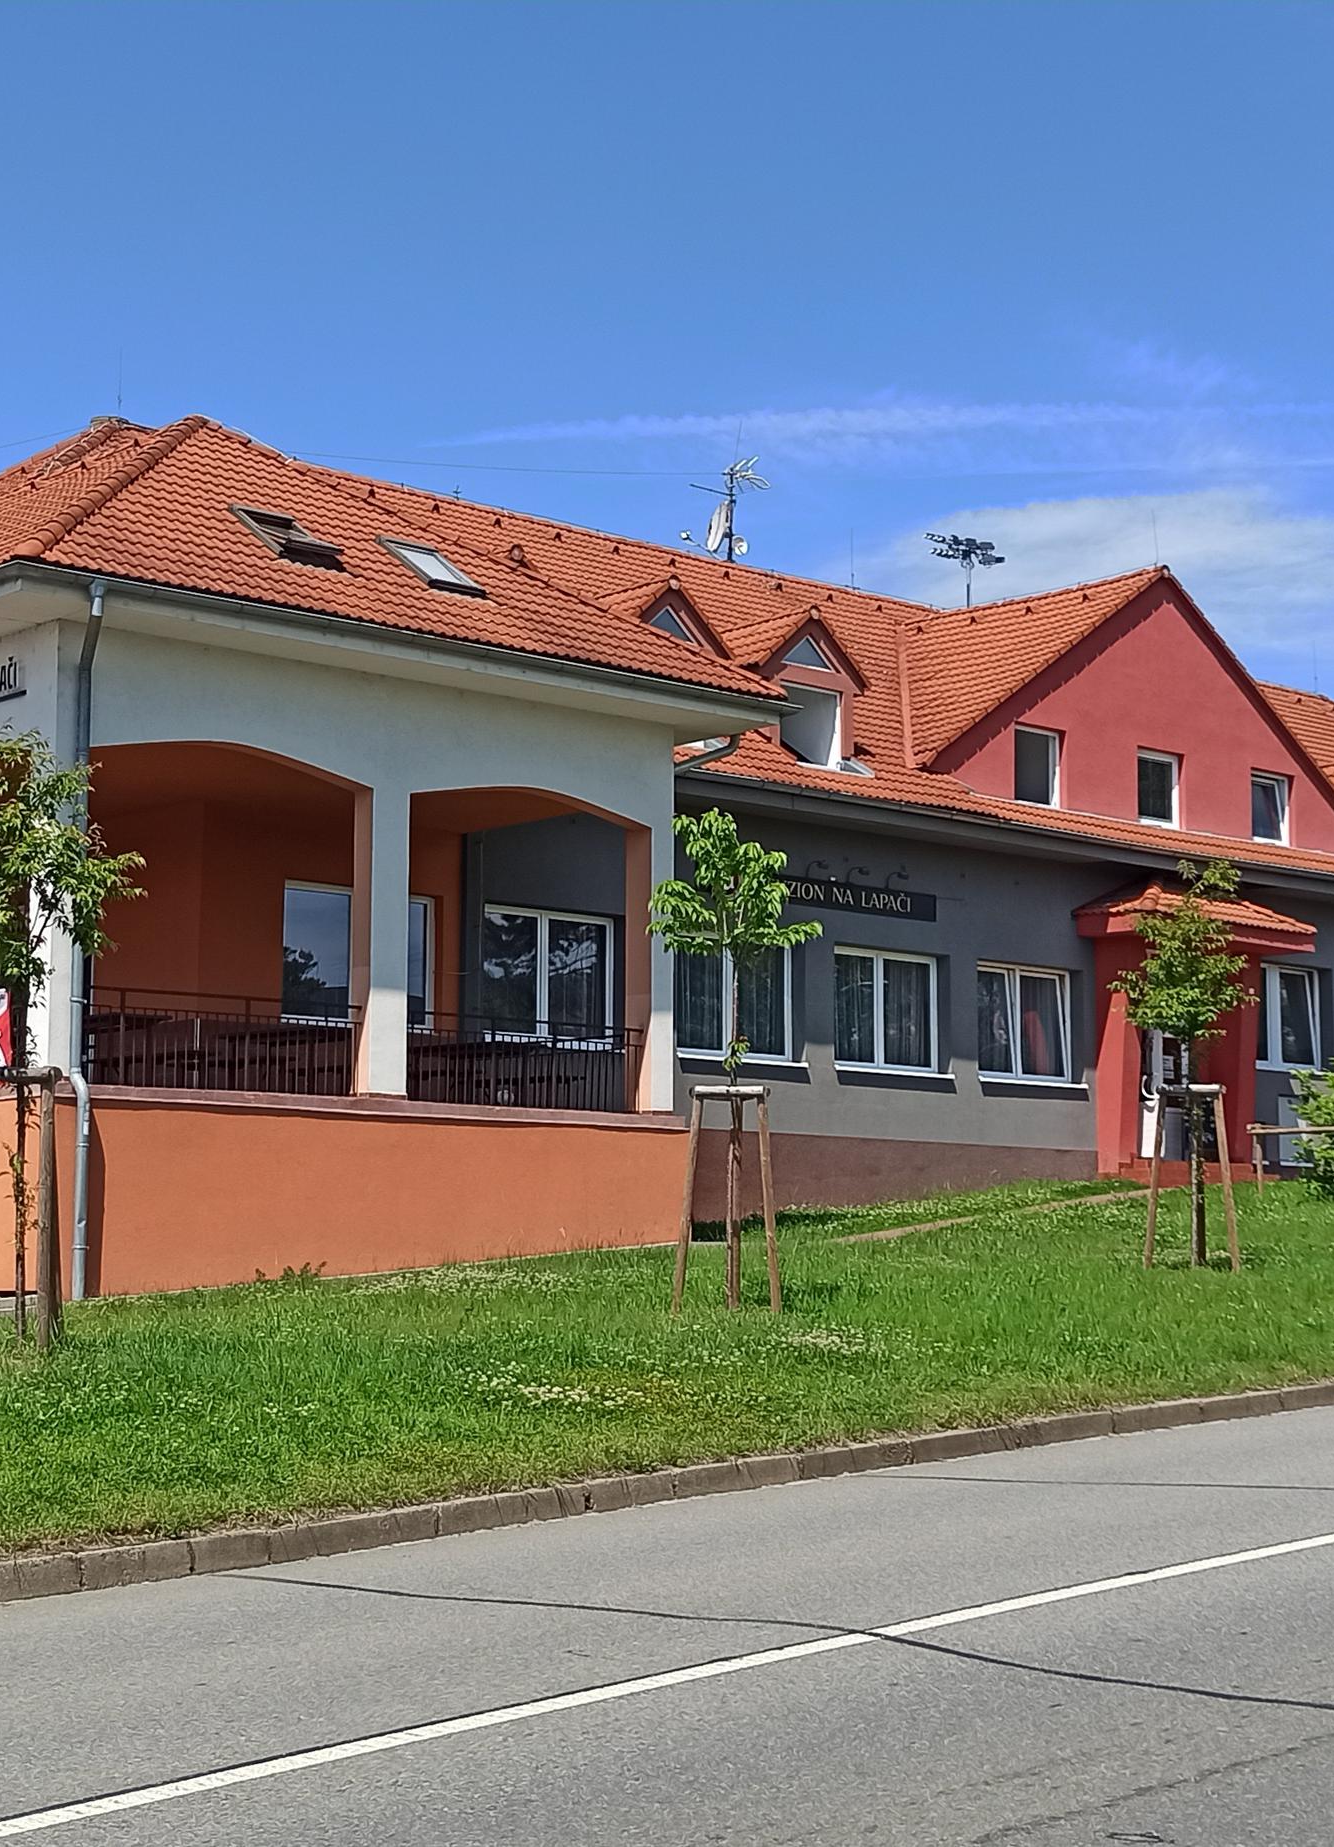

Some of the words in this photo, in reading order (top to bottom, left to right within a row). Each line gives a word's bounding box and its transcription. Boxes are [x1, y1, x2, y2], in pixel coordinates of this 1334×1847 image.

[785, 880, 825, 901] ZION
[832, 887, 854, 905] NA
[861, 892, 911, 913] LAPAČI
